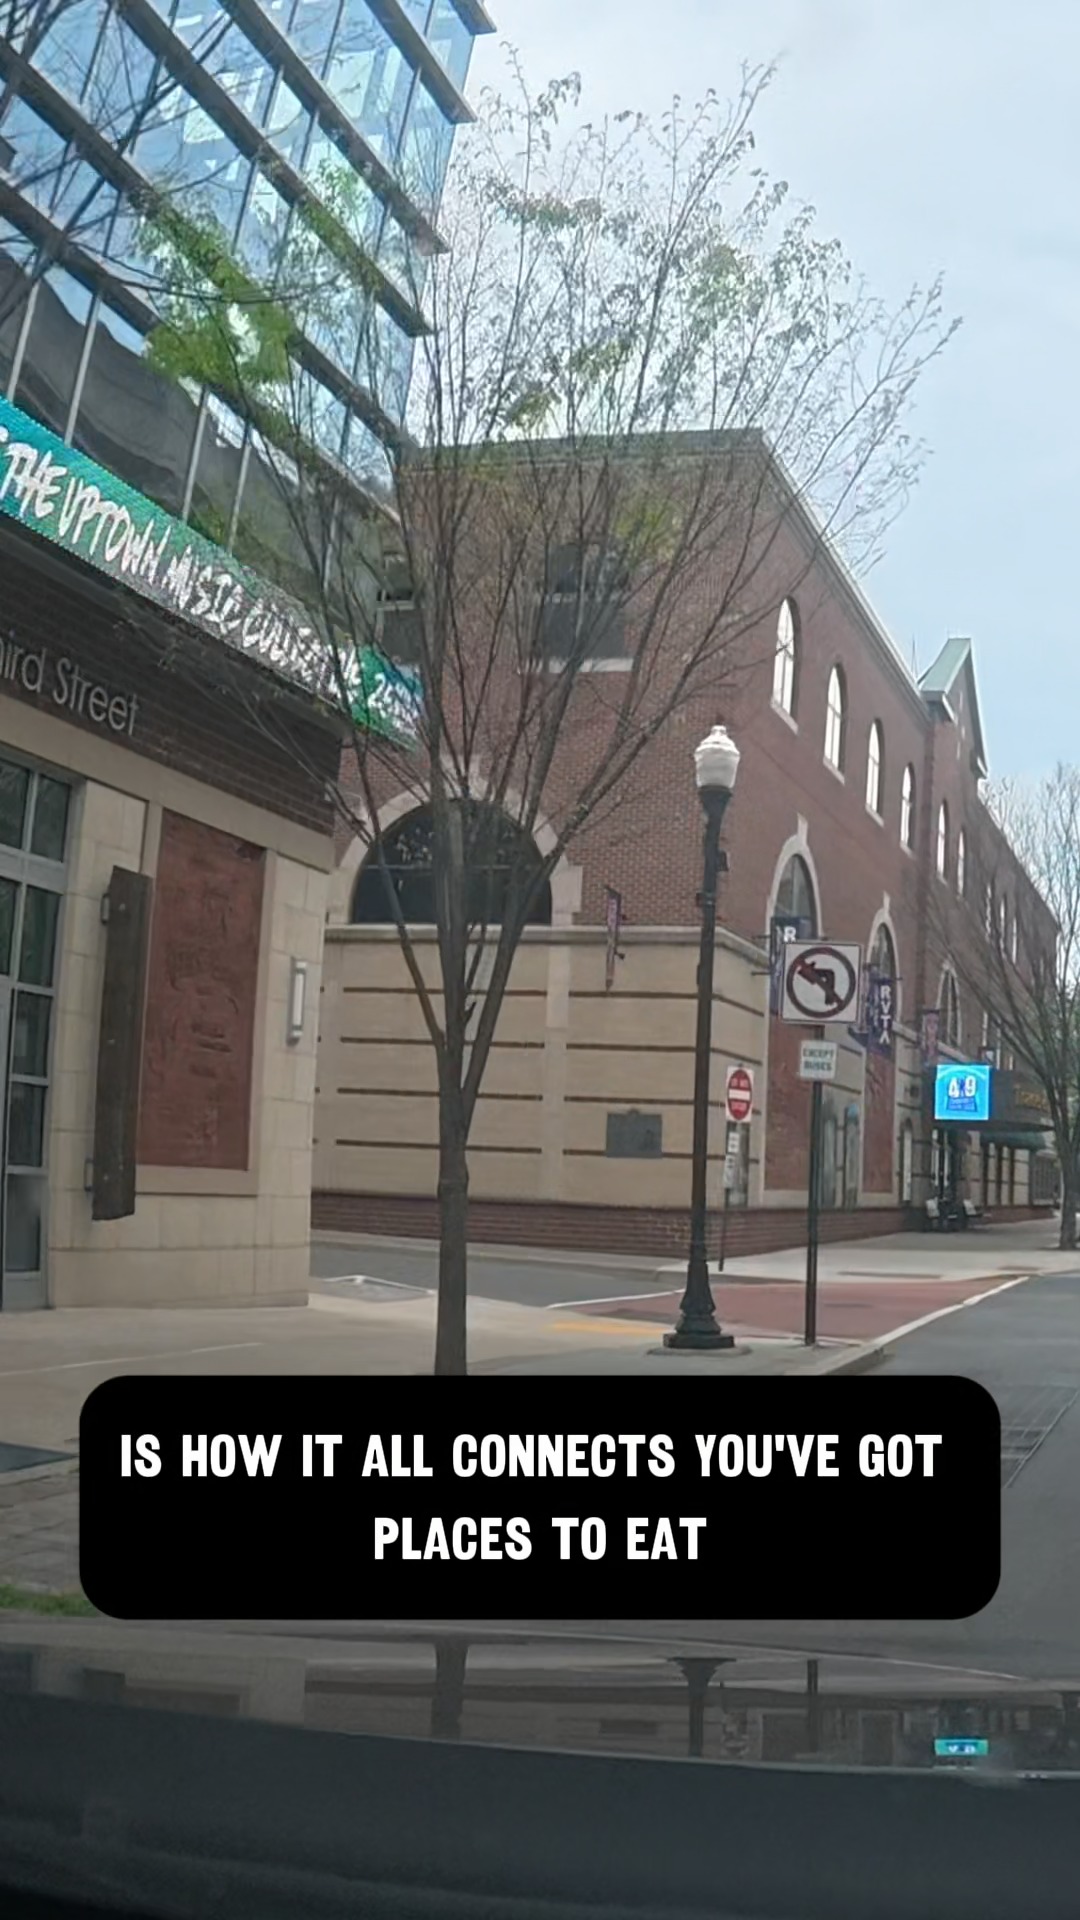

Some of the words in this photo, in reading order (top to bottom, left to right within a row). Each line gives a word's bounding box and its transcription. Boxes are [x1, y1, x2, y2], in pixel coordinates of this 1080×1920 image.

[0, 442, 67, 518] THE
[58, 476, 171, 584] UPTOWN
[161, 544, 245, 635] MUSIC
[53, 657, 139, 736] Street
